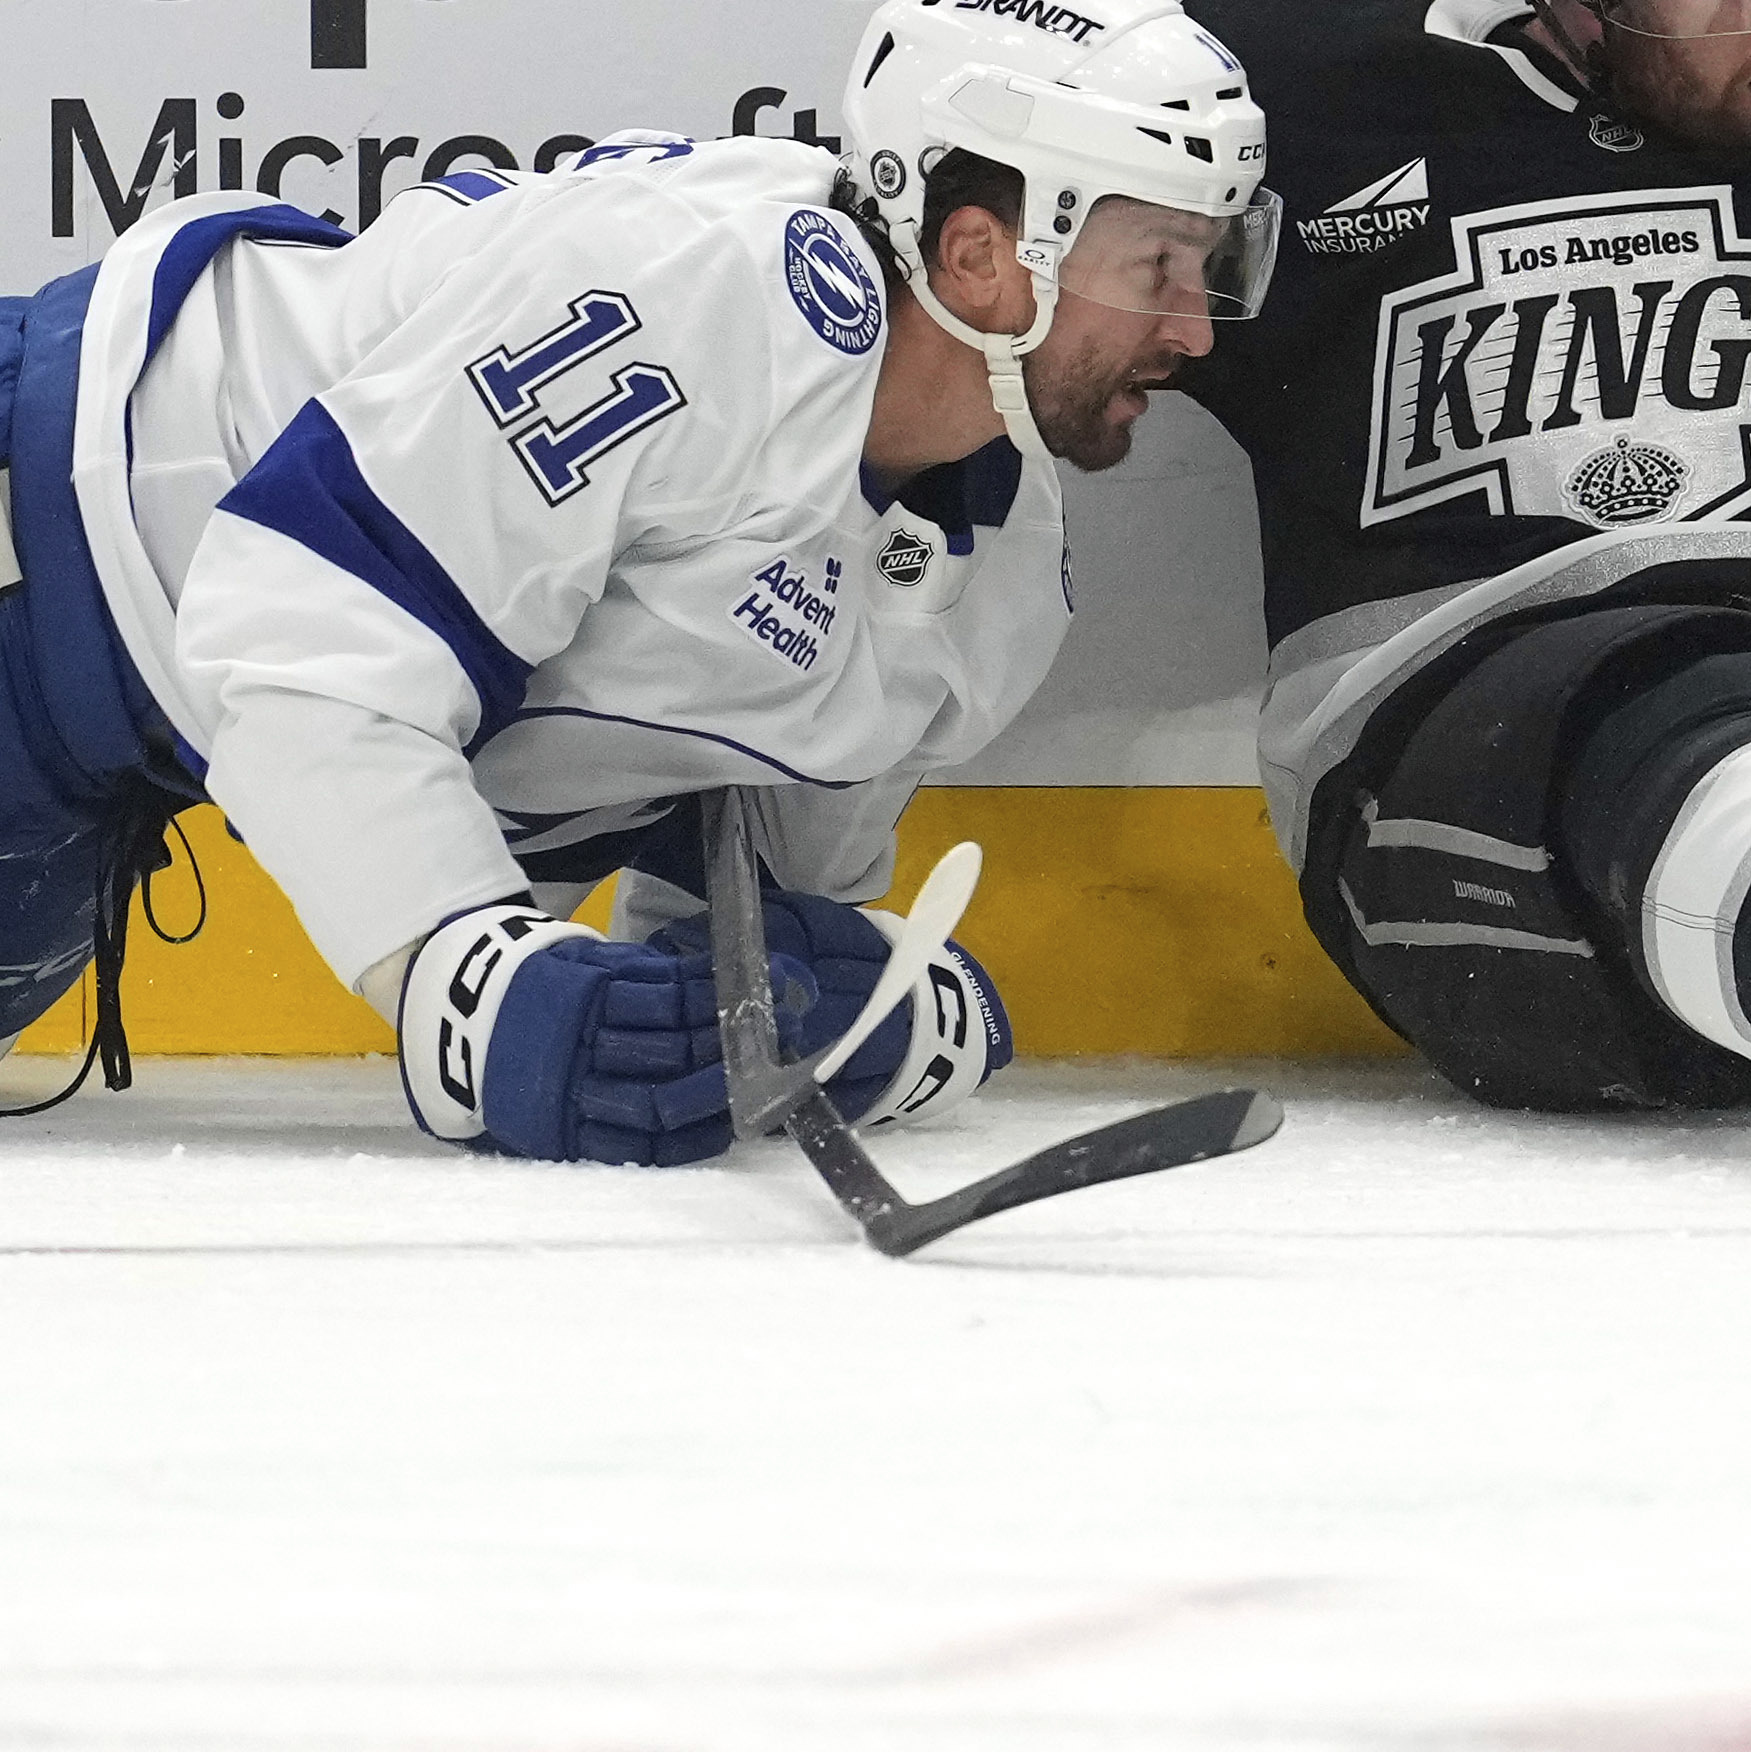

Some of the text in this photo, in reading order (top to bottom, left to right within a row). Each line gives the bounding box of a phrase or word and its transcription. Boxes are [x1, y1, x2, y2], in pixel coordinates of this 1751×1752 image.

[1296, 204, 1430, 239] MERCURY
[1304, 232, 1404, 253] INSURA
[1499, 228, 1699, 275] Los Angeles
[789, 264, 801, 293] CLUB
[791, 213, 880, 349] TAMPA BAY LIGHTNING
[794, 256, 811, 300] HOCKEY
[464, 289, 688, 508] 11
[884, 552, 923, 569] NHL
[754, 559, 836, 635] Advent
[733, 592, 818, 671] Health
[1452, 879, 1516, 908] WARRIOR
[950, 951, 1001, 1046] GLENDENING
[866, 963, 968, 1128] CC
